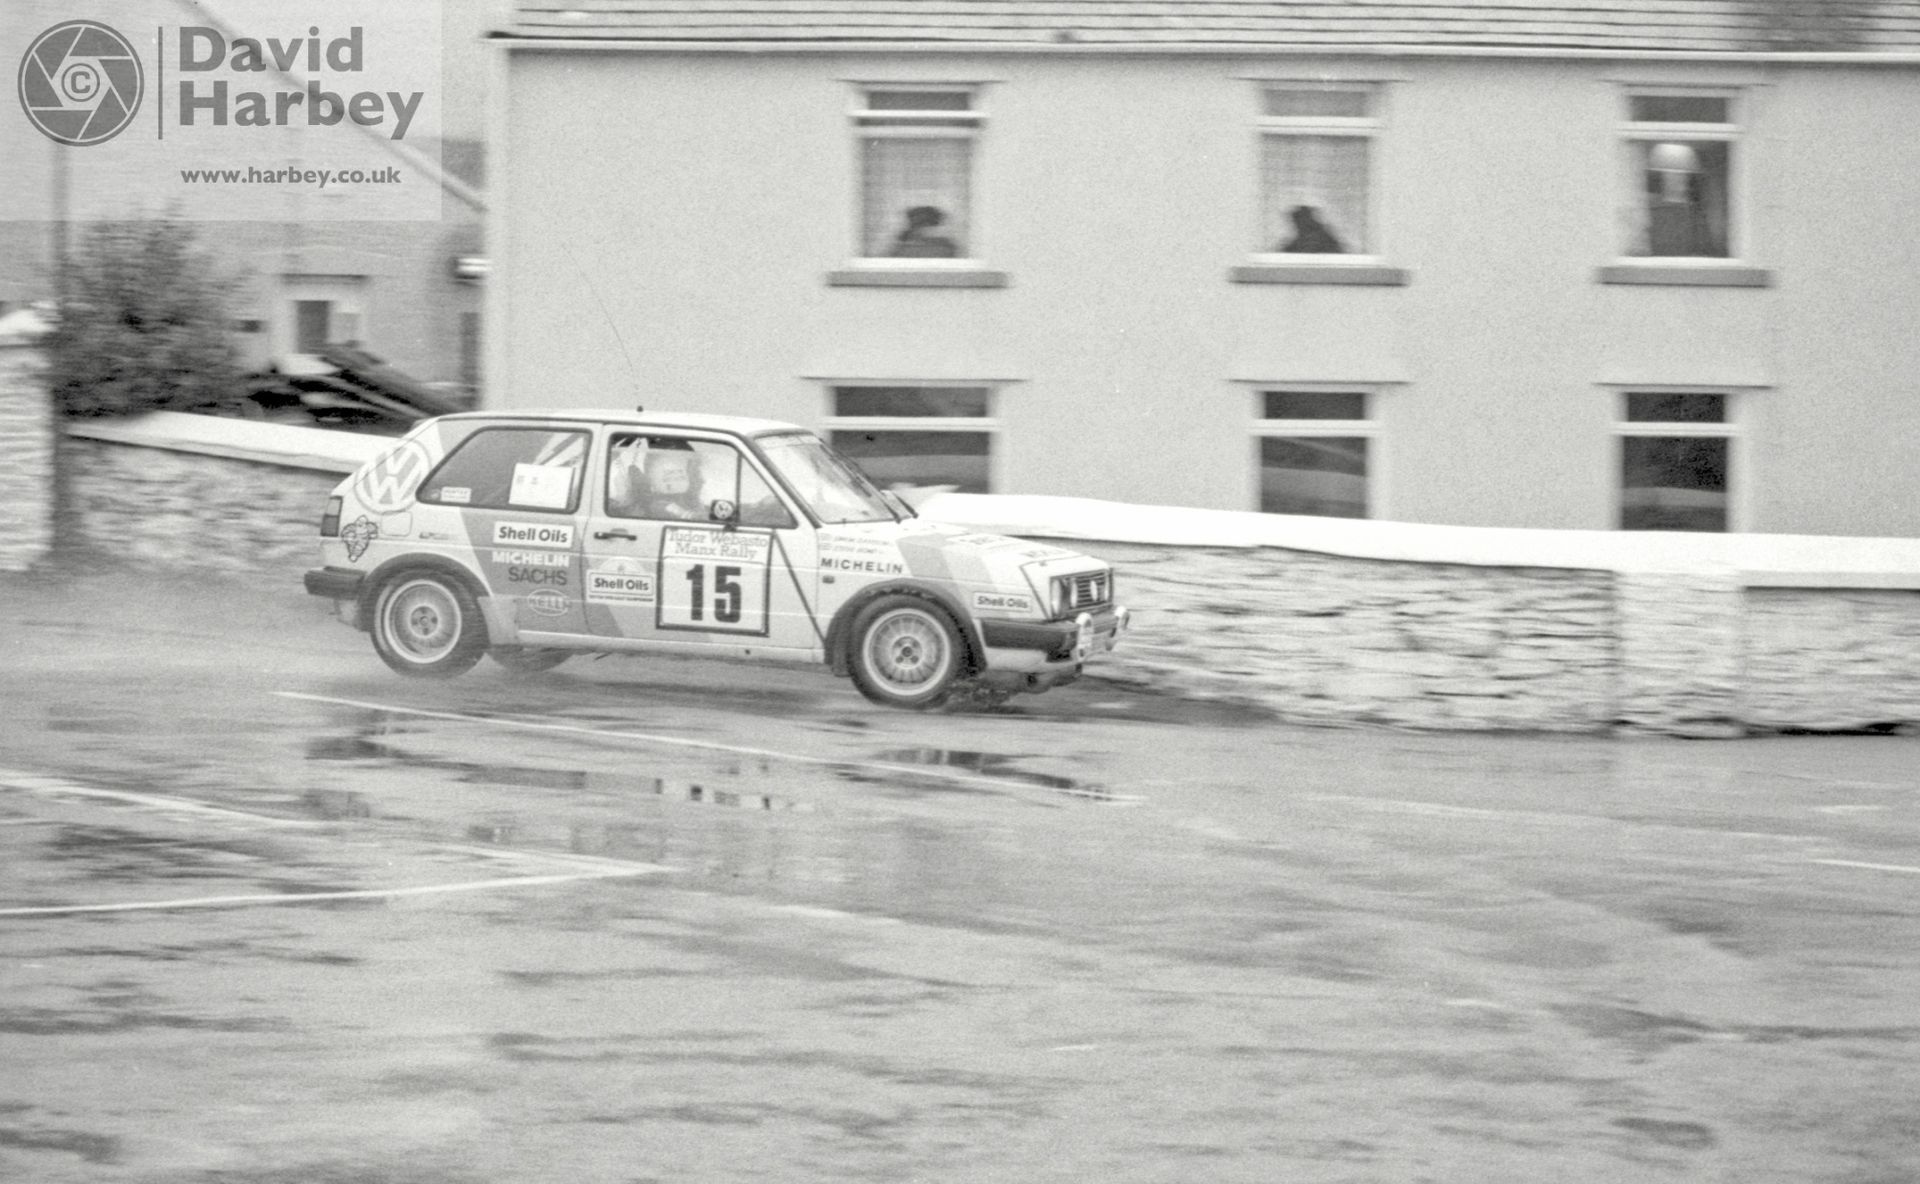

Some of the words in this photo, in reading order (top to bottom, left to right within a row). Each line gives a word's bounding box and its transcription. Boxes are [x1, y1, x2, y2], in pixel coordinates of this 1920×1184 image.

[498, 526, 536, 541] Shell
[538, 528, 568, 543] Oils
[669, 529, 706, 543] Tudor
[709, 531, 769, 547] Webasto
[492, 551, 570, 568] MICHELIN
[675, 542, 717, 556] Manx
[720, 545, 758, 560] Rally
[820, 557, 904, 574] MICHELIN
[508, 566, 568, 586] SACHS
[594, 577, 624, 590] Shell
[625, 579, 649, 591] Oils
[686, 563, 742, 624] 15
